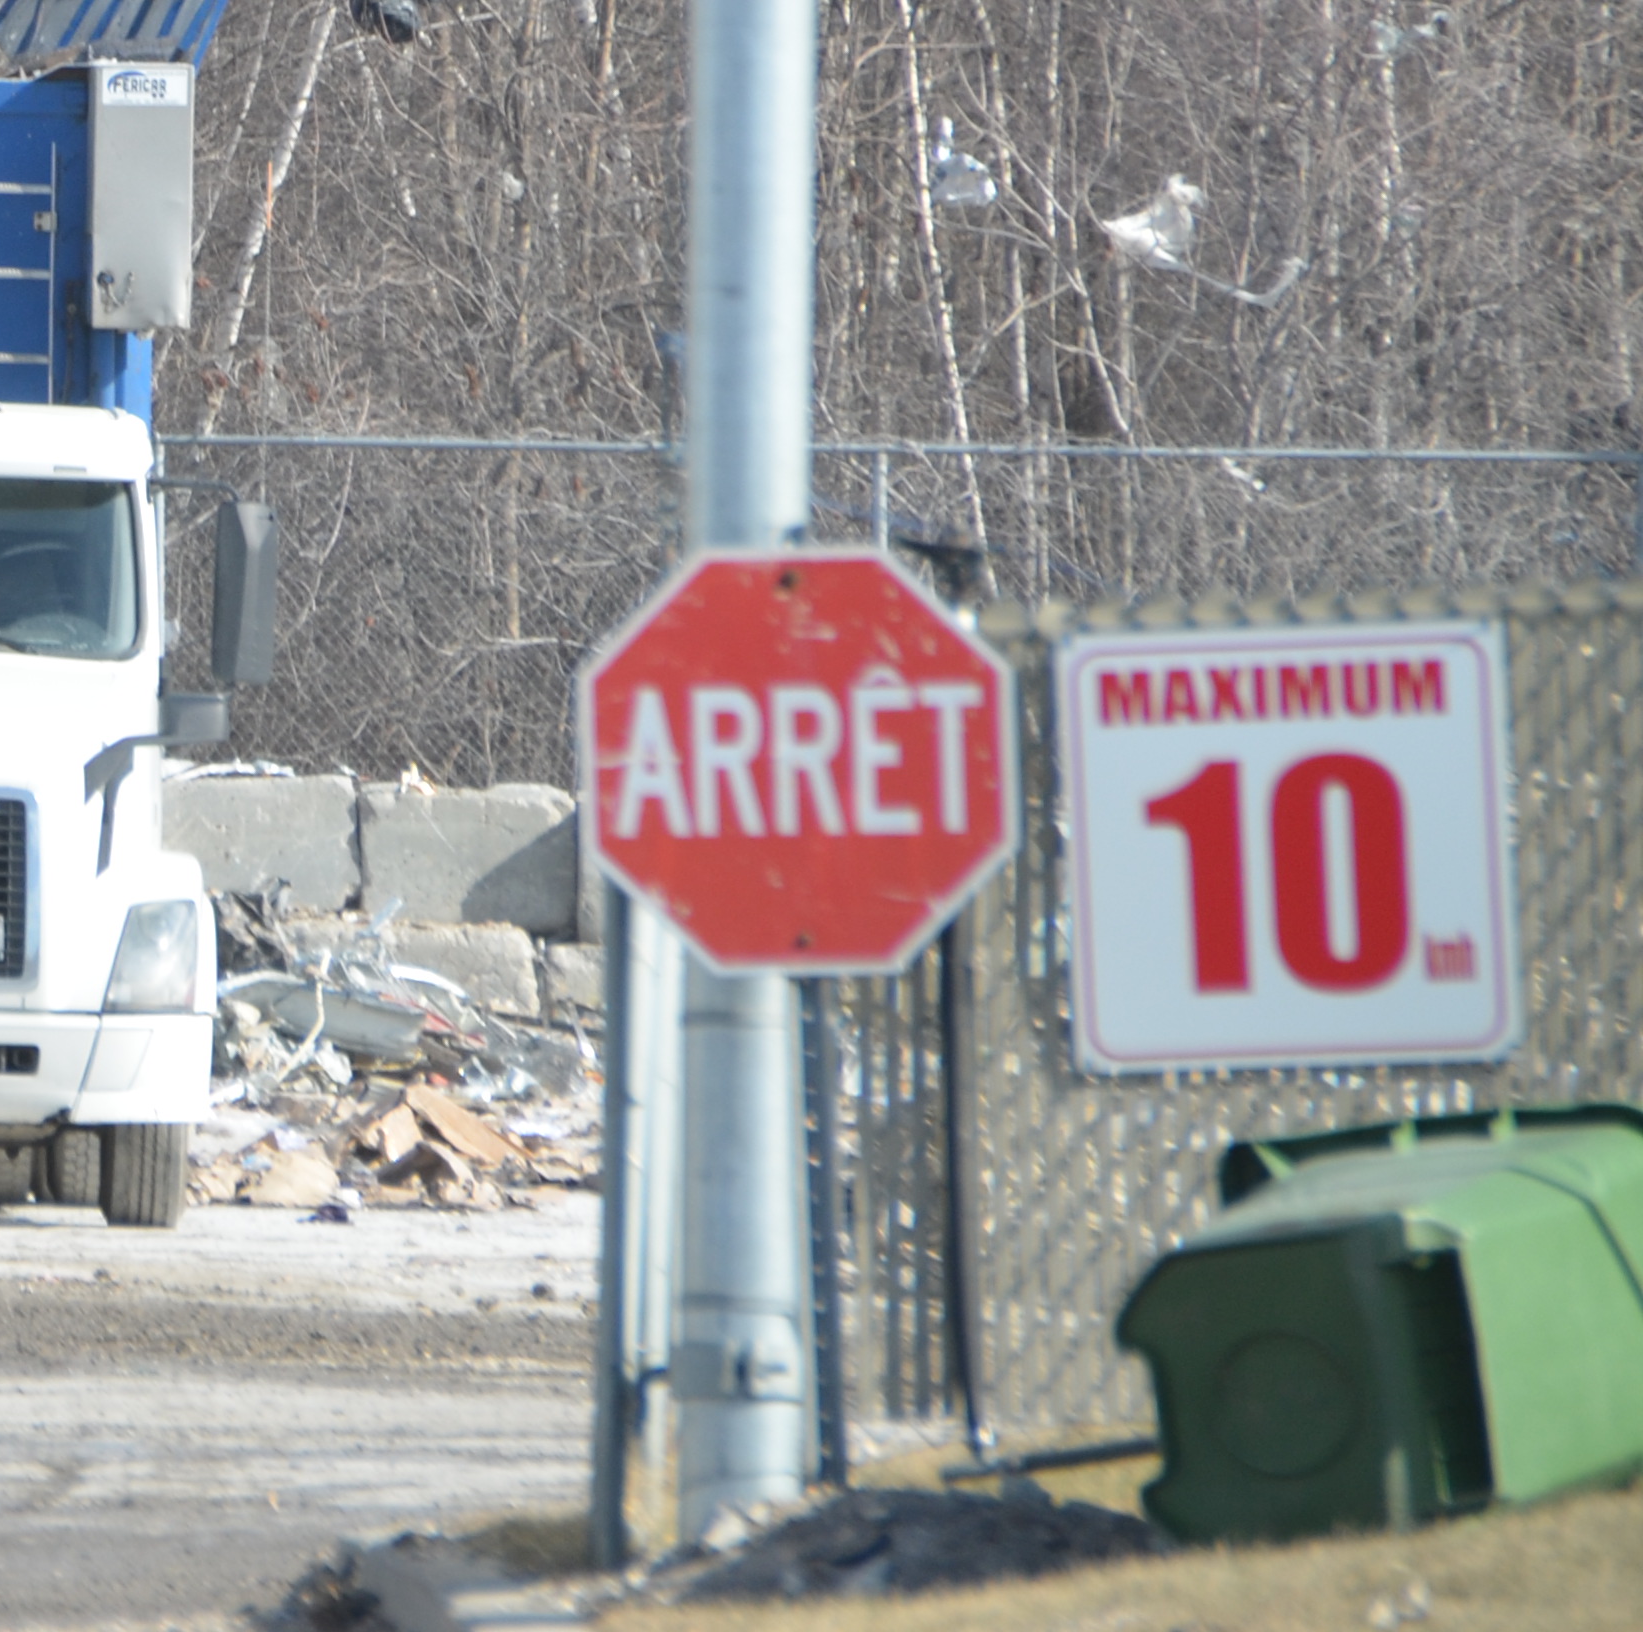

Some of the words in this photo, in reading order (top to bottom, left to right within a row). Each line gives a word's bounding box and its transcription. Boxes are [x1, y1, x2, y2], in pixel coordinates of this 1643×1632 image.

[615, 665, 984, 839] ARRÊT
[1098, 659, 1446, 726] MAXIMUM
[1145, 752, 1411, 994] 10
